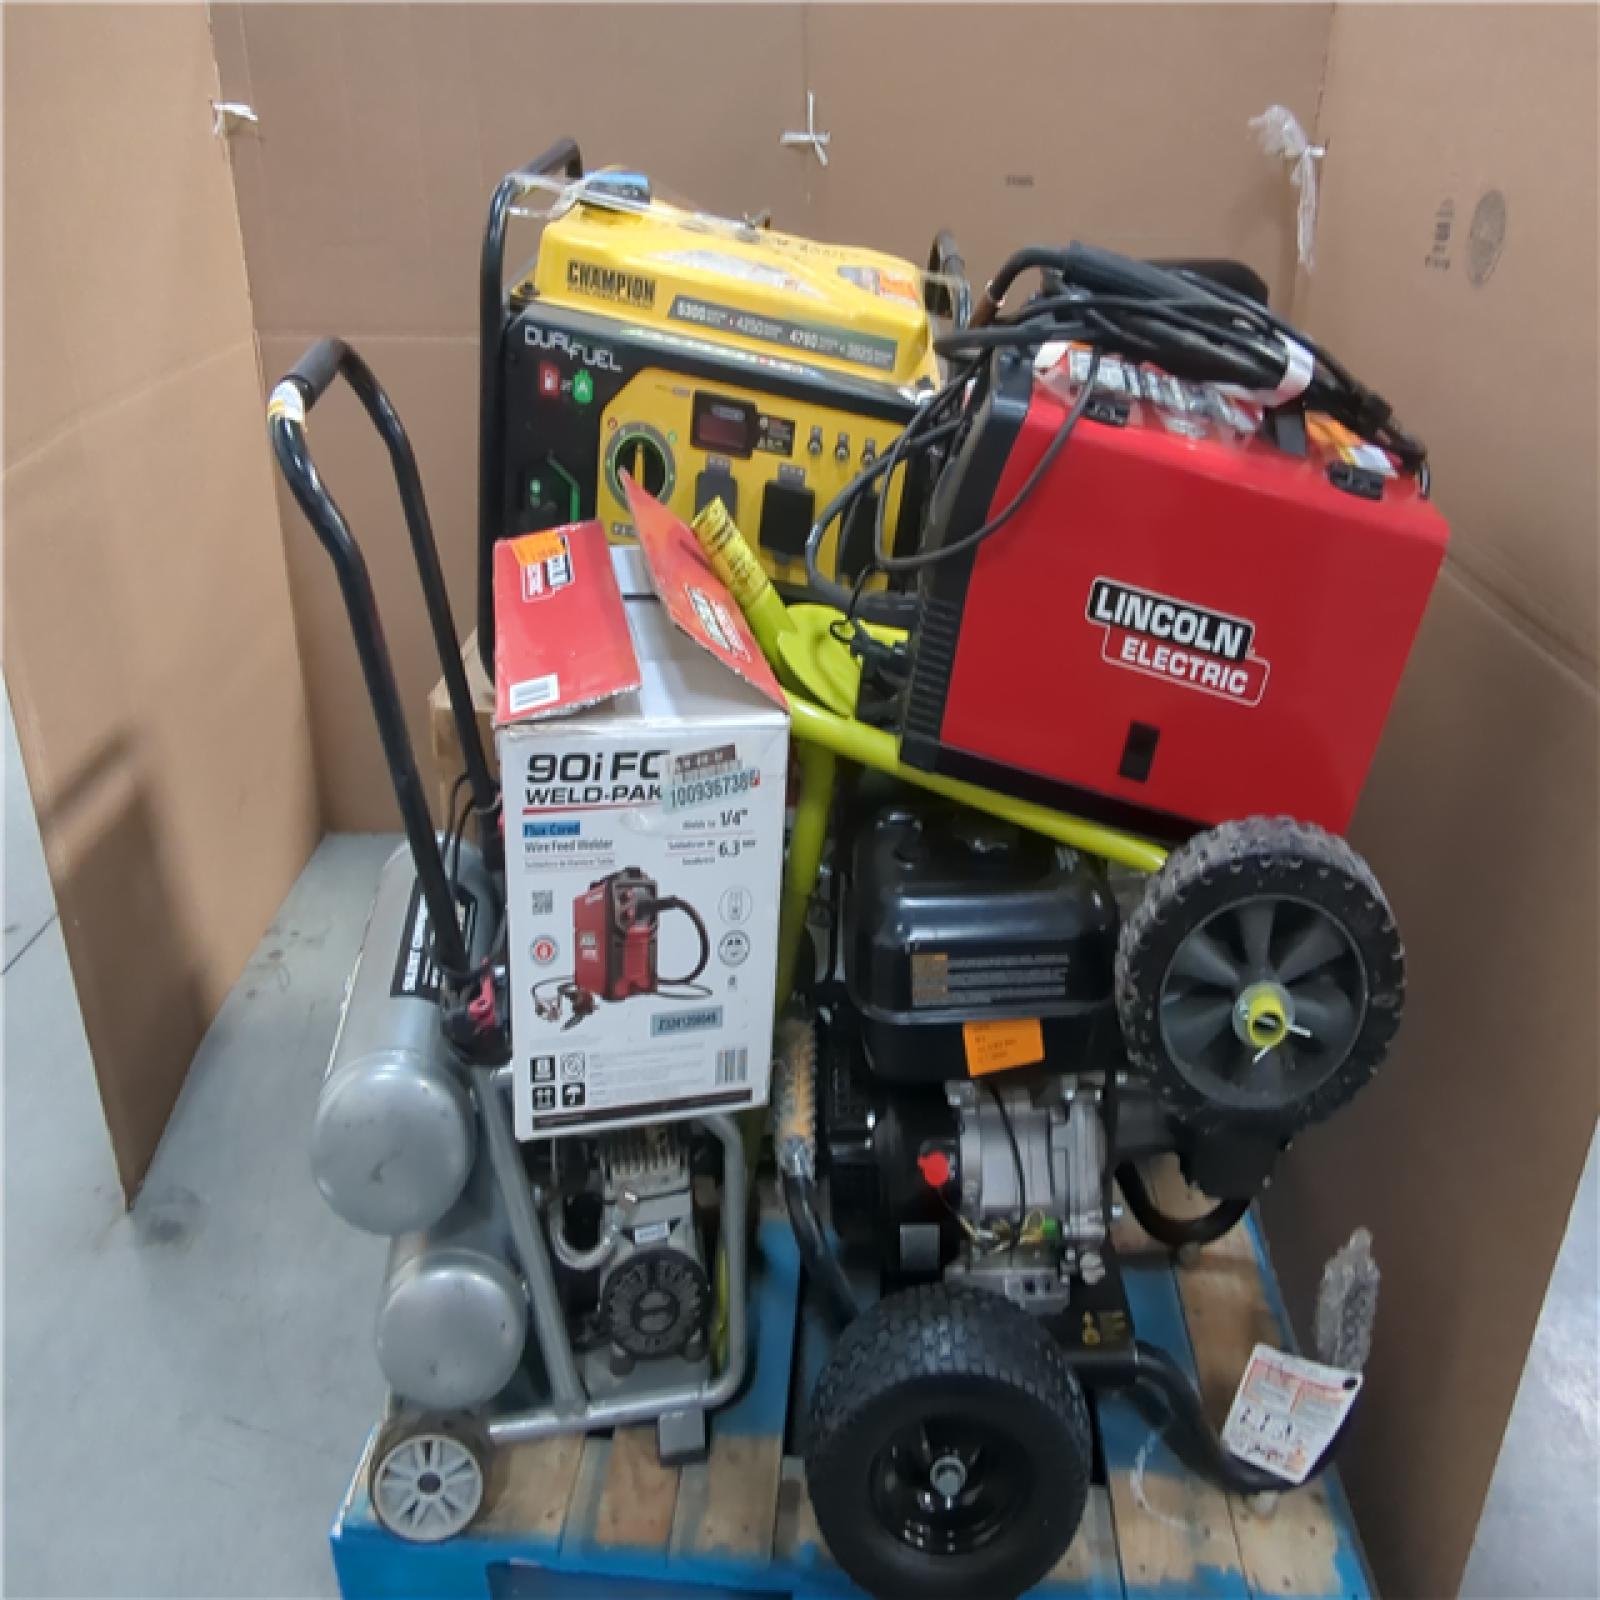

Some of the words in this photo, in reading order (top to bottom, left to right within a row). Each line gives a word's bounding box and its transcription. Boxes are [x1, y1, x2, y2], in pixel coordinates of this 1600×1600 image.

[567, 259, 657, 305] CHAMPION
[1095, 586, 1243, 658] LINCOLN
[1122, 636, 1248, 694] ELECTRIC
[525, 784, 663, 806] WELD-PAK
